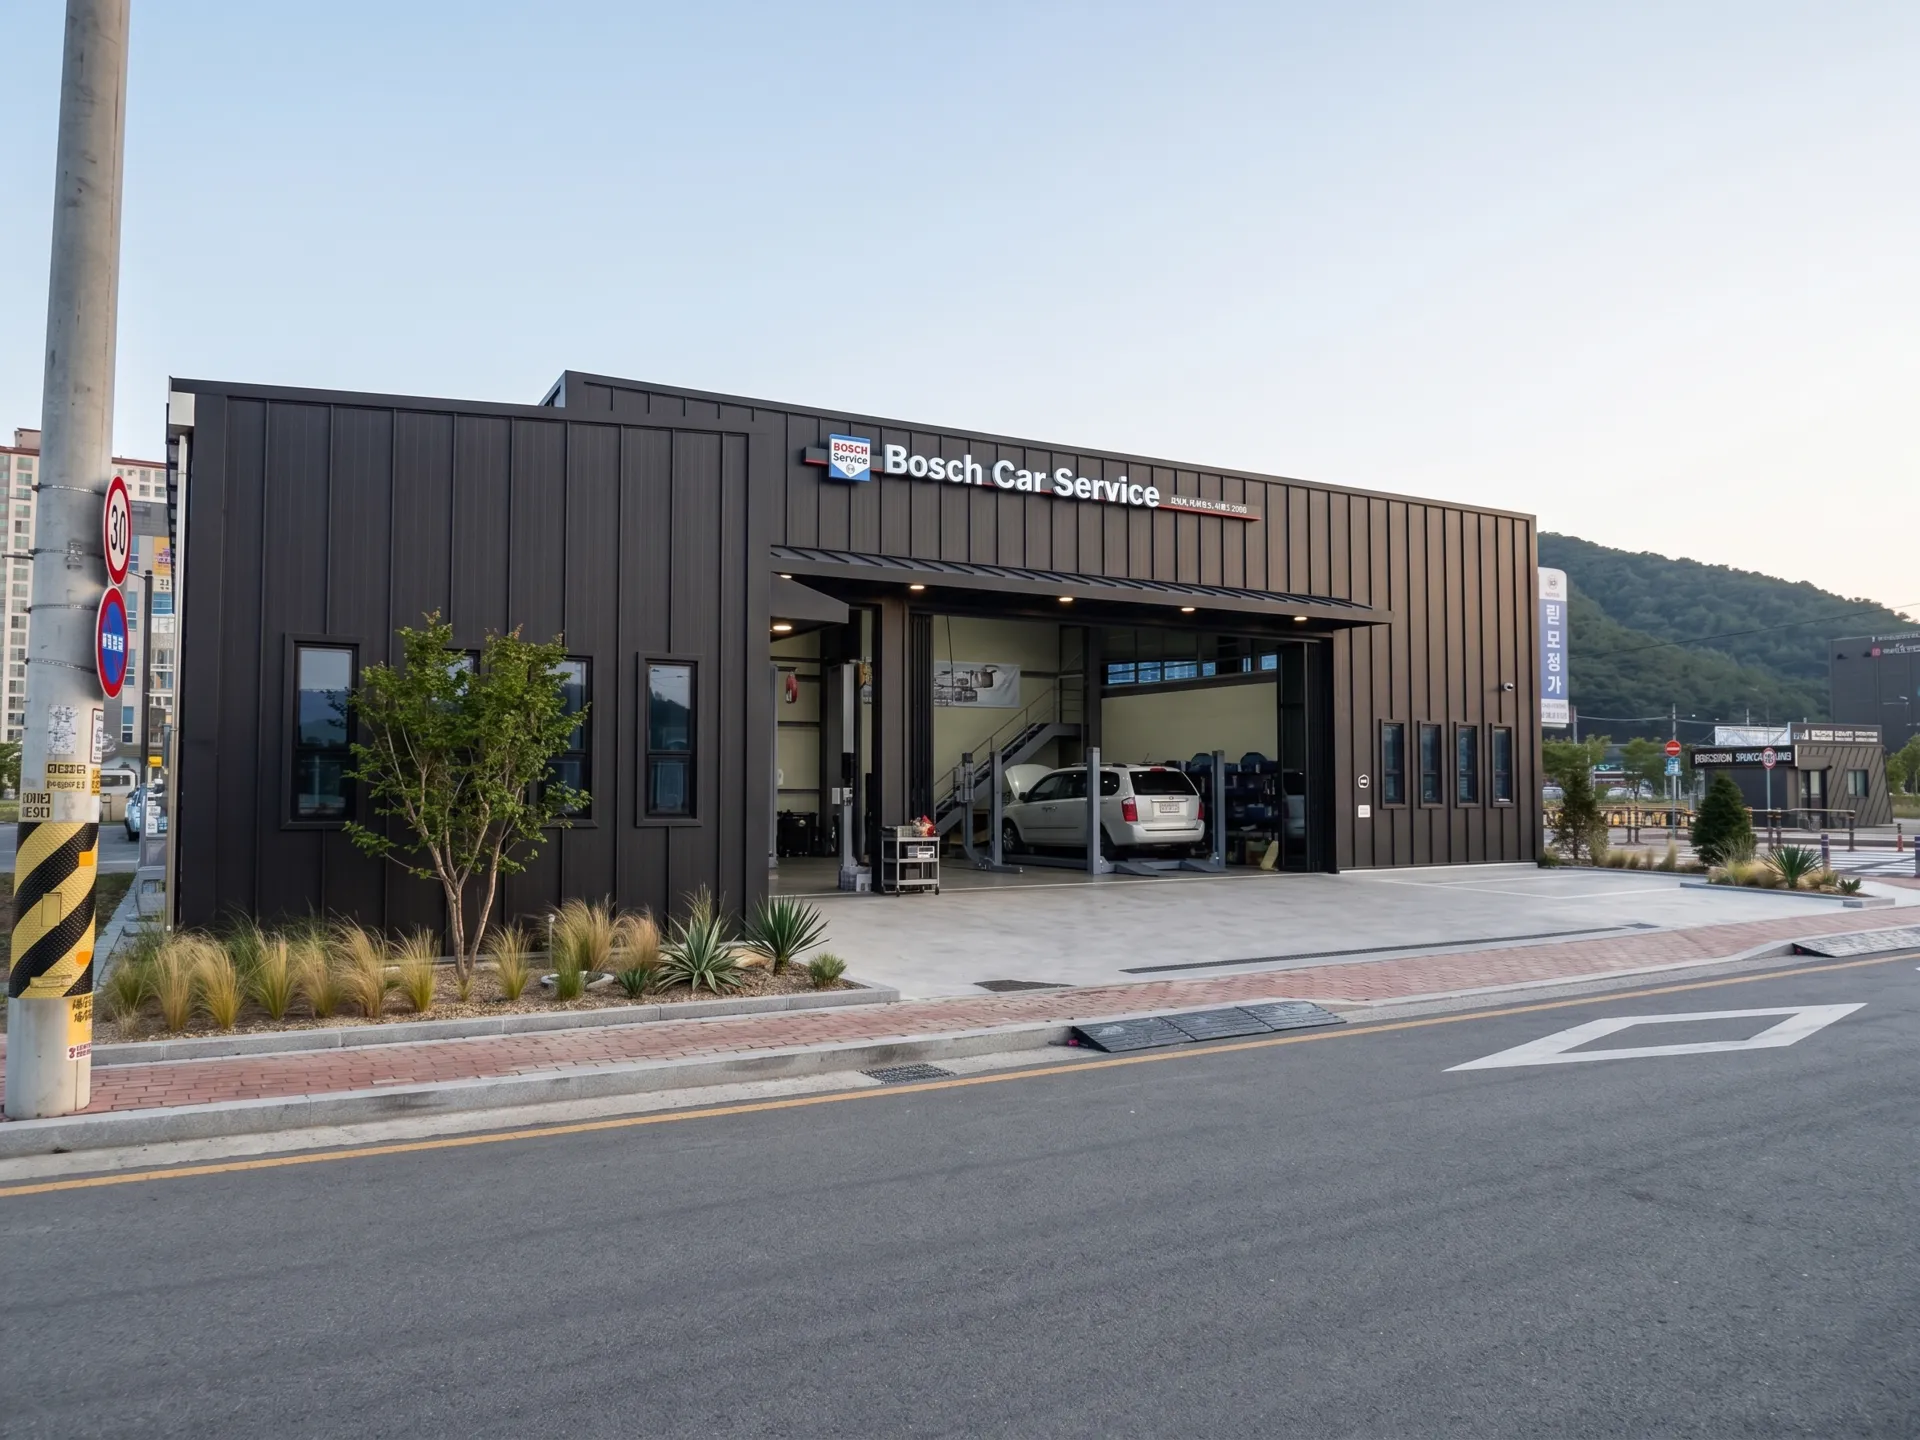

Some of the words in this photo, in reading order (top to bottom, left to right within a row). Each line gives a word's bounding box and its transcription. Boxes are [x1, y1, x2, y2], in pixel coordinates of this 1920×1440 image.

[833, 442, 868, 455] BOSCH
[833, 452, 868, 465] Service
[885, 444, 983, 486] Bosch
[991, 459, 1047, 493] Car
[1053, 467, 1160, 508] Service
[110, 504, 126, 556] 30
